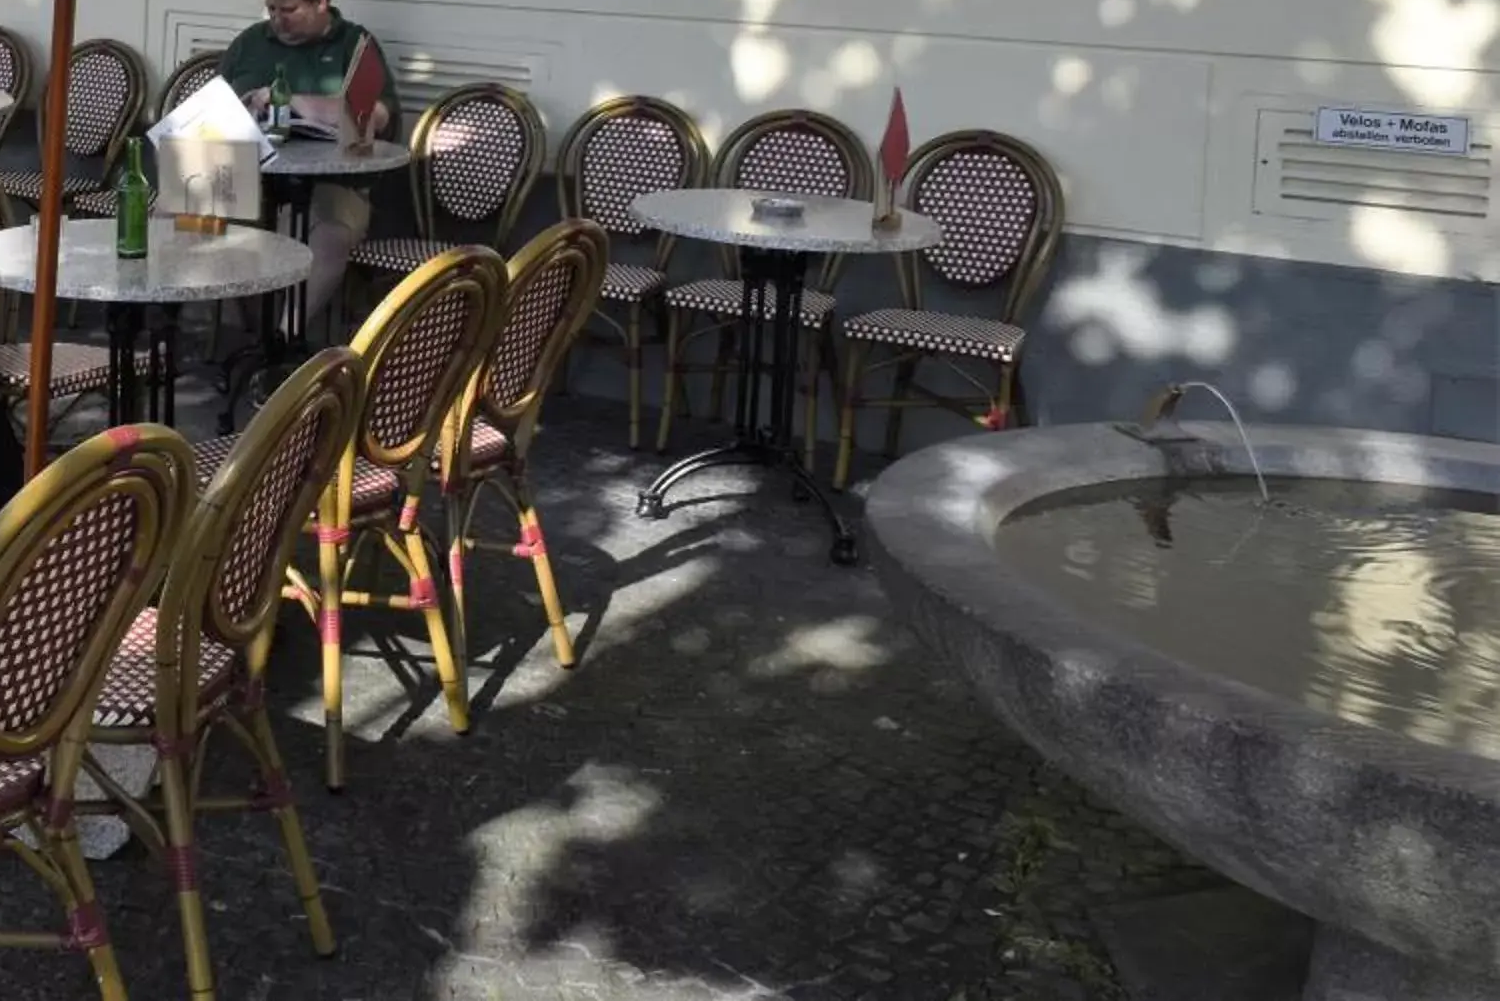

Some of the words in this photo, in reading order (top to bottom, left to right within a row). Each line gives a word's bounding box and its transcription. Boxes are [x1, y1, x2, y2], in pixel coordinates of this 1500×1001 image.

[1340, 113, 1382, 129] Velos
[1399, 118, 1449, 135] Mofas
[1394, 134, 1451, 147] verboten
